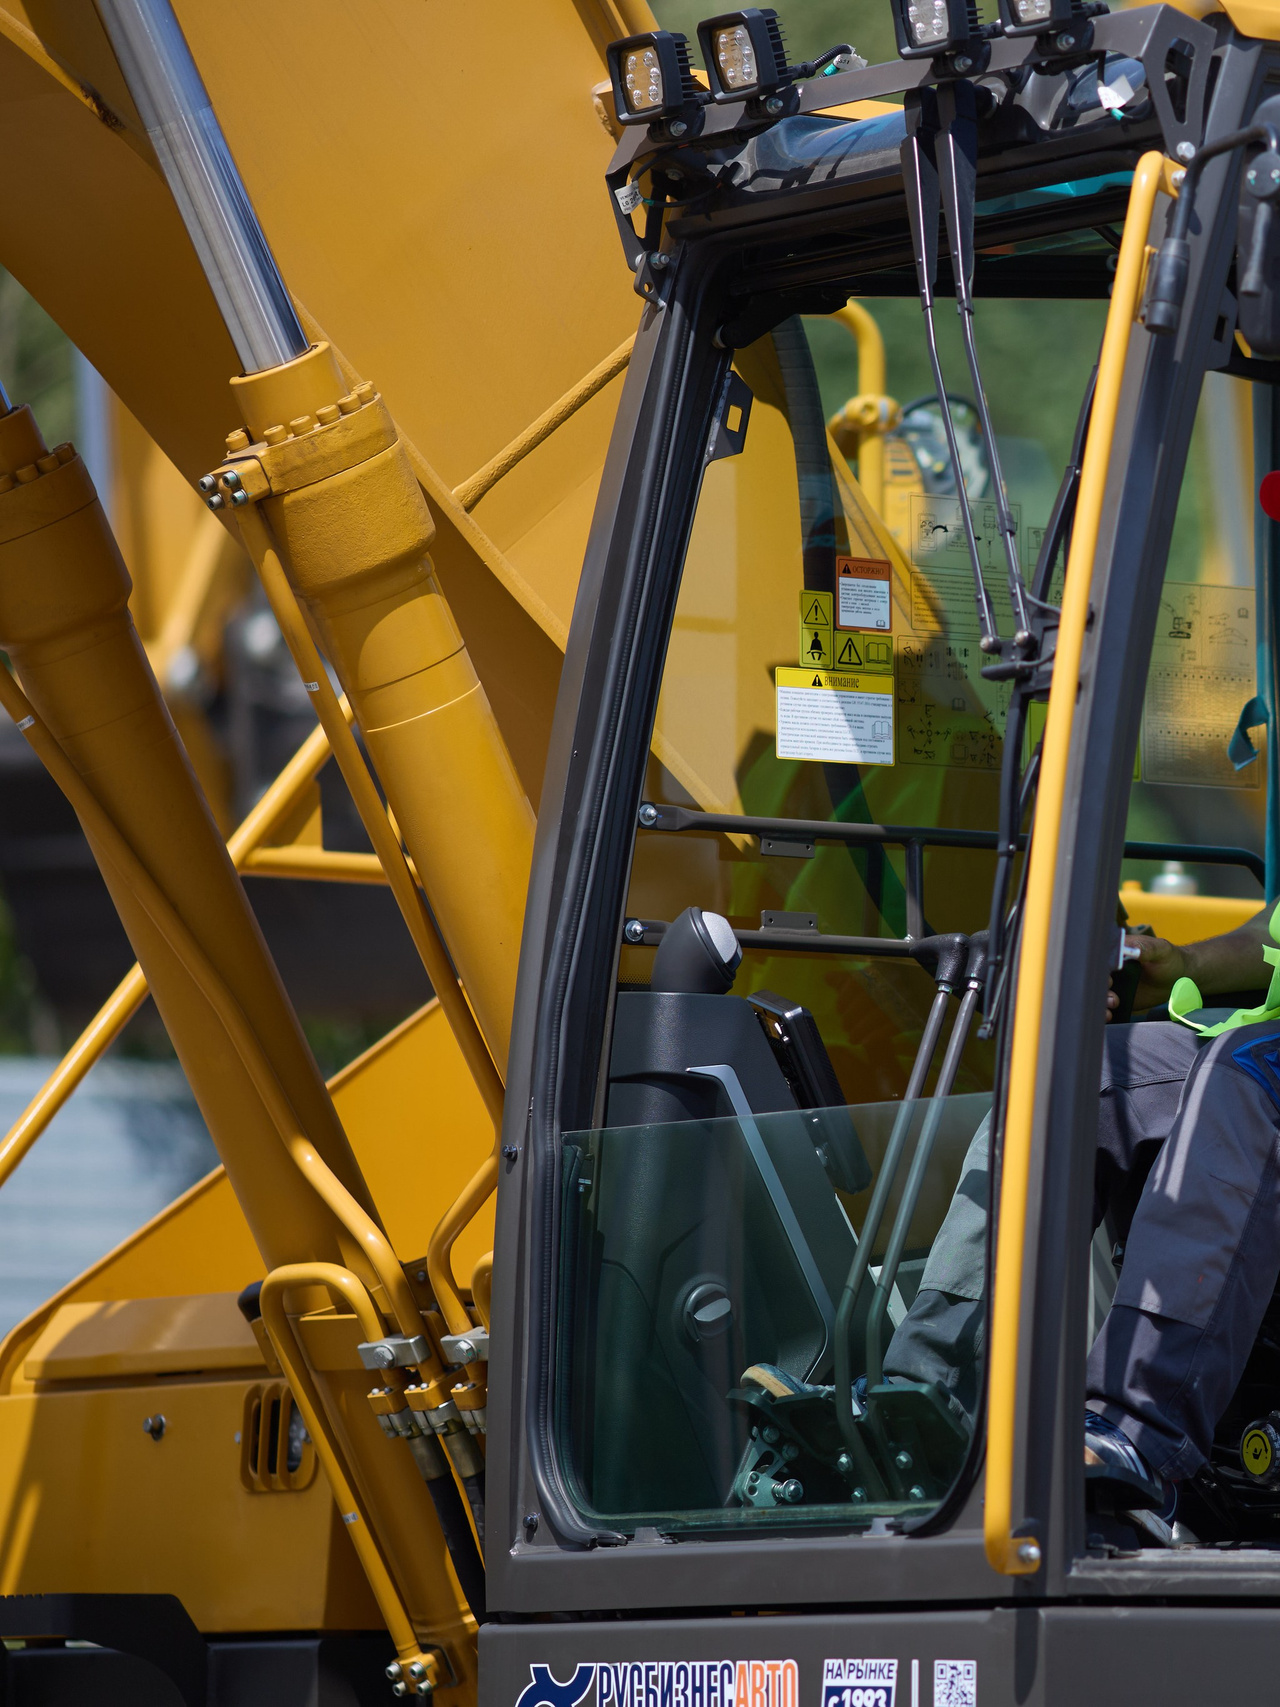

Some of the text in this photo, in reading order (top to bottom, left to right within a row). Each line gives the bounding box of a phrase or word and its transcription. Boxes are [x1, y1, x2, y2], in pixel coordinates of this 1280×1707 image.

[598, 1661, 798, 1707] РУСБИЗНЕСАВТО
[826, 1663, 895, 1680] НА РЫНКЕ
